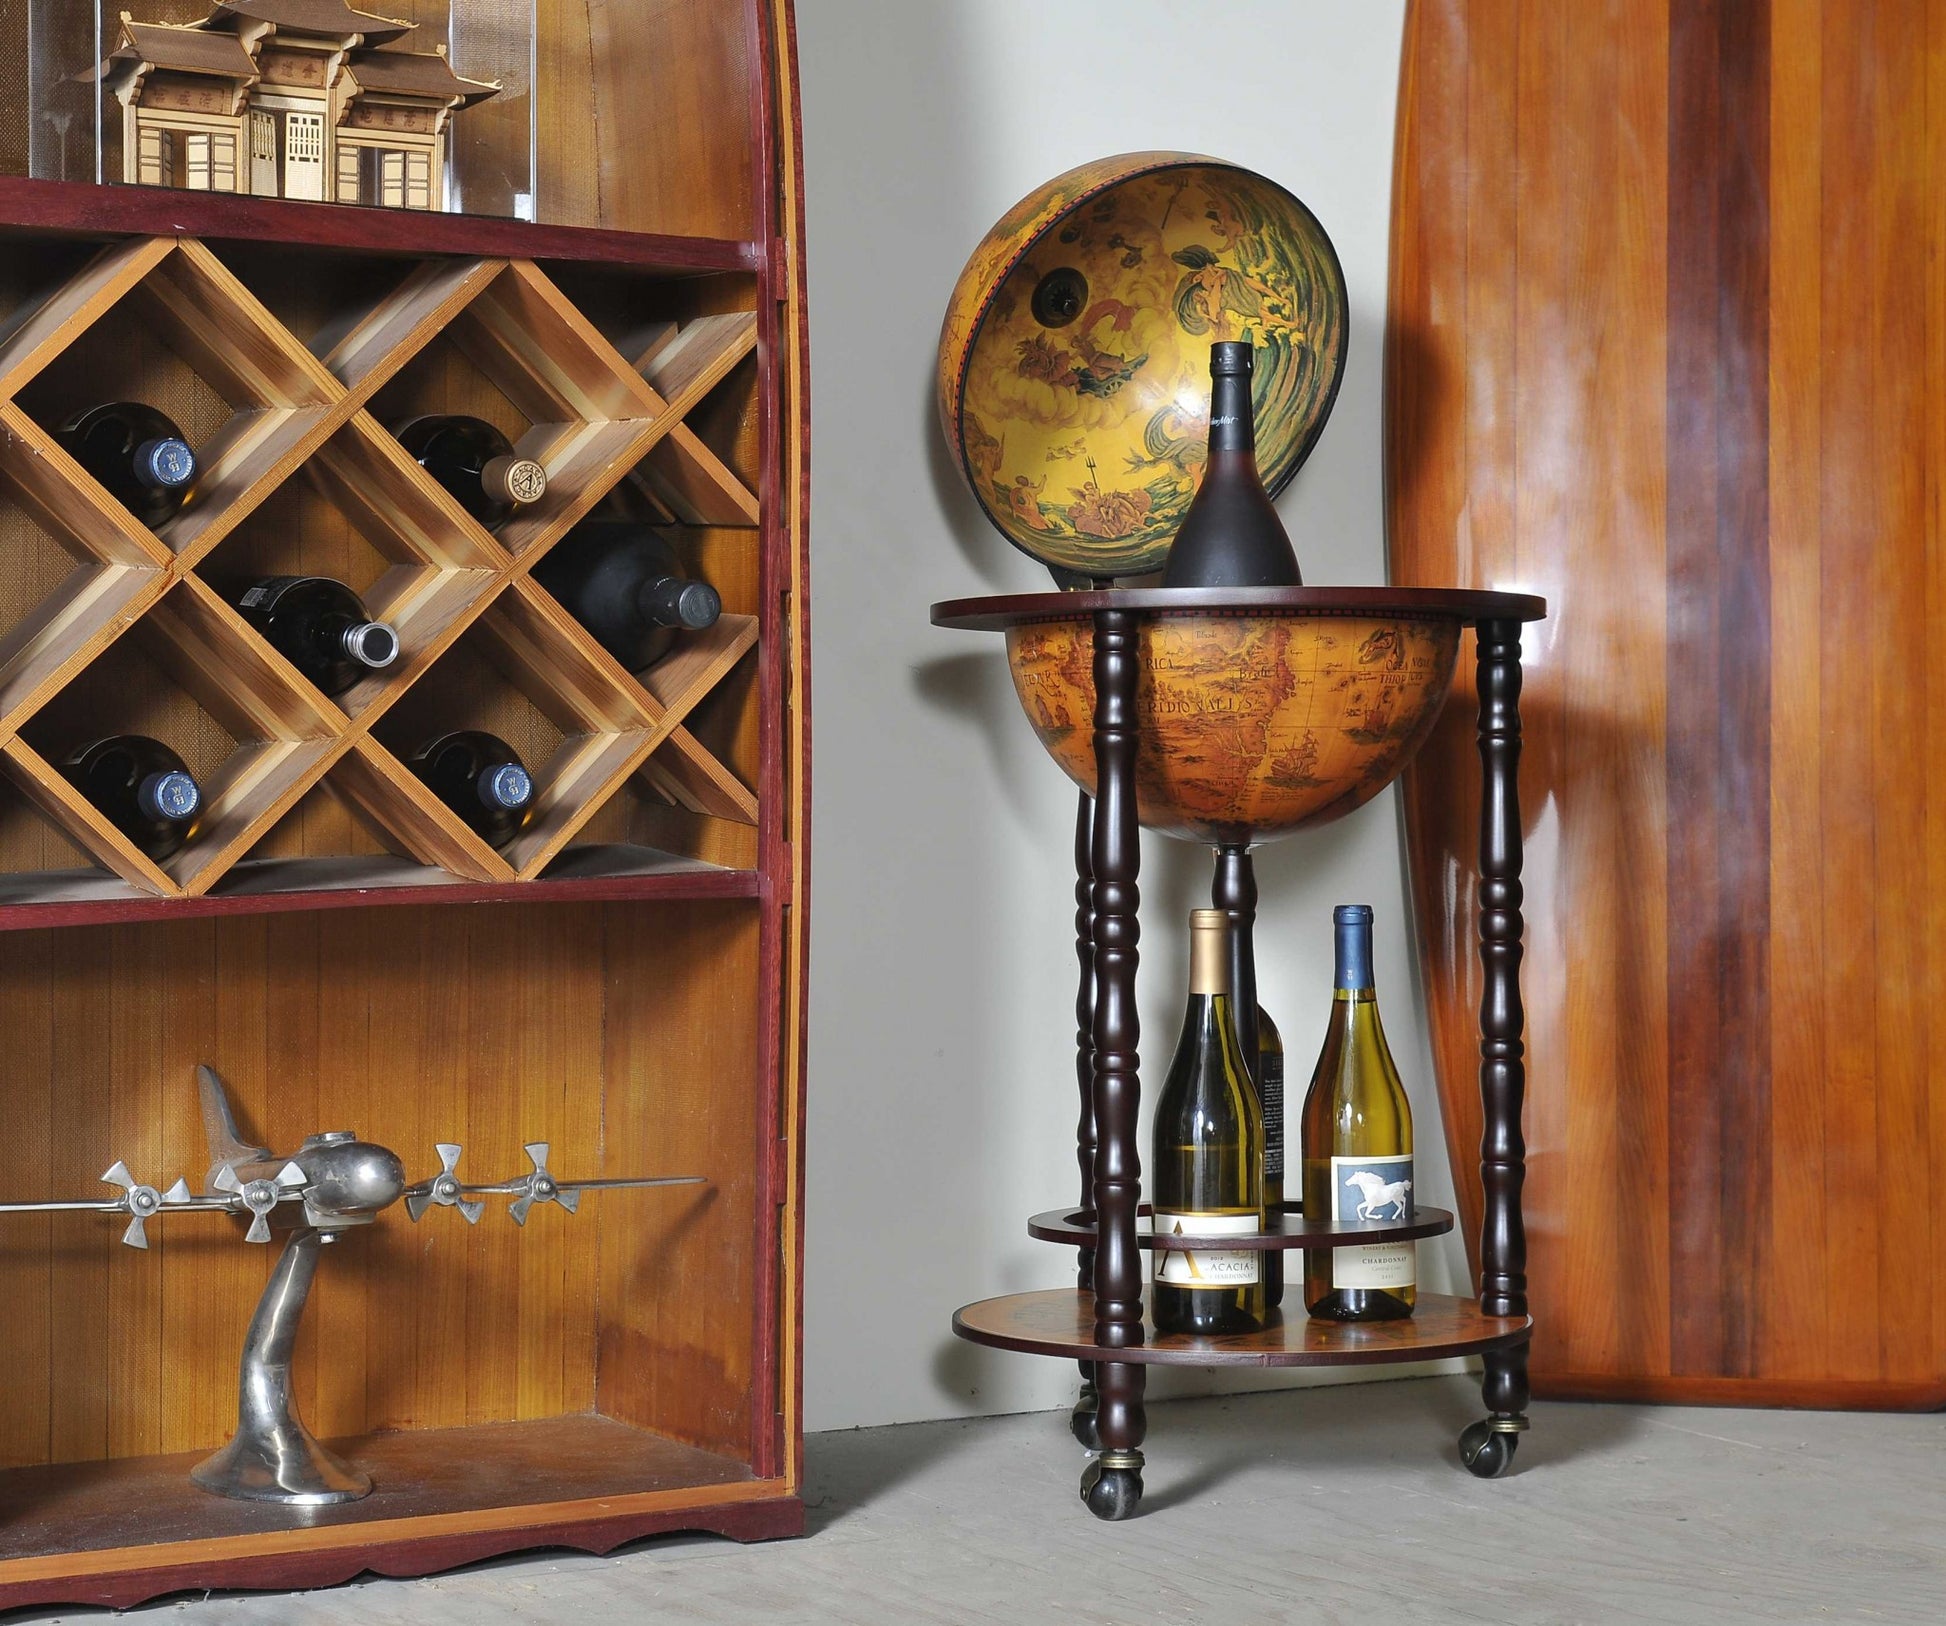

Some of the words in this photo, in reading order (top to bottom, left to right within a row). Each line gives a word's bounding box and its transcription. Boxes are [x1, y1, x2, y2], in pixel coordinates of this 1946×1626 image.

[519, 473, 533, 490] A
[1362, 1256, 1407, 1264] CHARDONNAY
[1210, 1262, 1250, 1272] ACACIA
